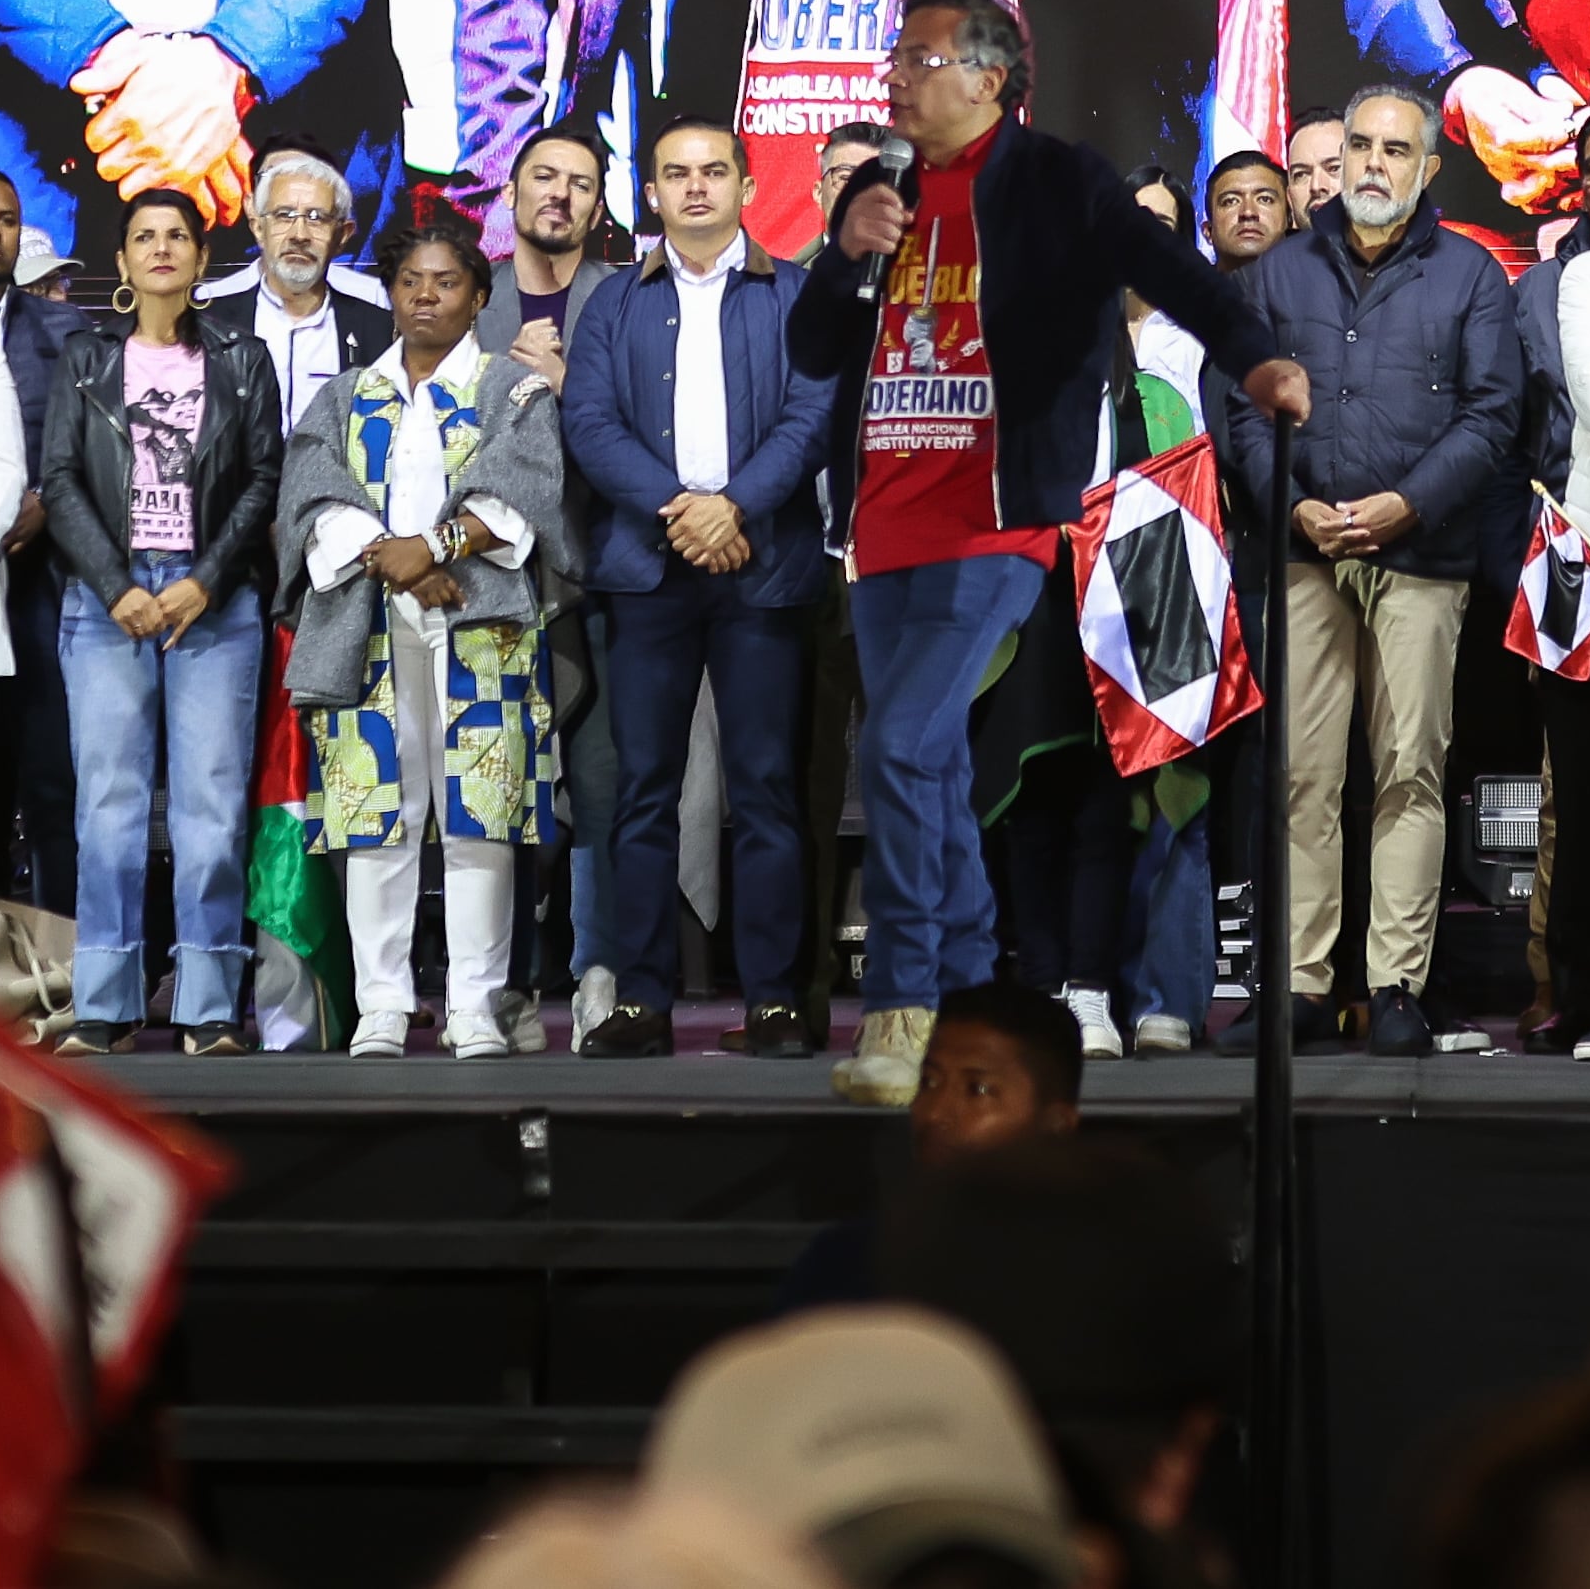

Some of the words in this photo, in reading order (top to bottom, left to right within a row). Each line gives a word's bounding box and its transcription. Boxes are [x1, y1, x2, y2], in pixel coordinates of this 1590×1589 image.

[888, 265, 979, 304] UEBLO
[886, 352, 906, 373] ES
[868, 379, 988, 414] OBERANO
[911, 423, 975, 435] NACIONAL
